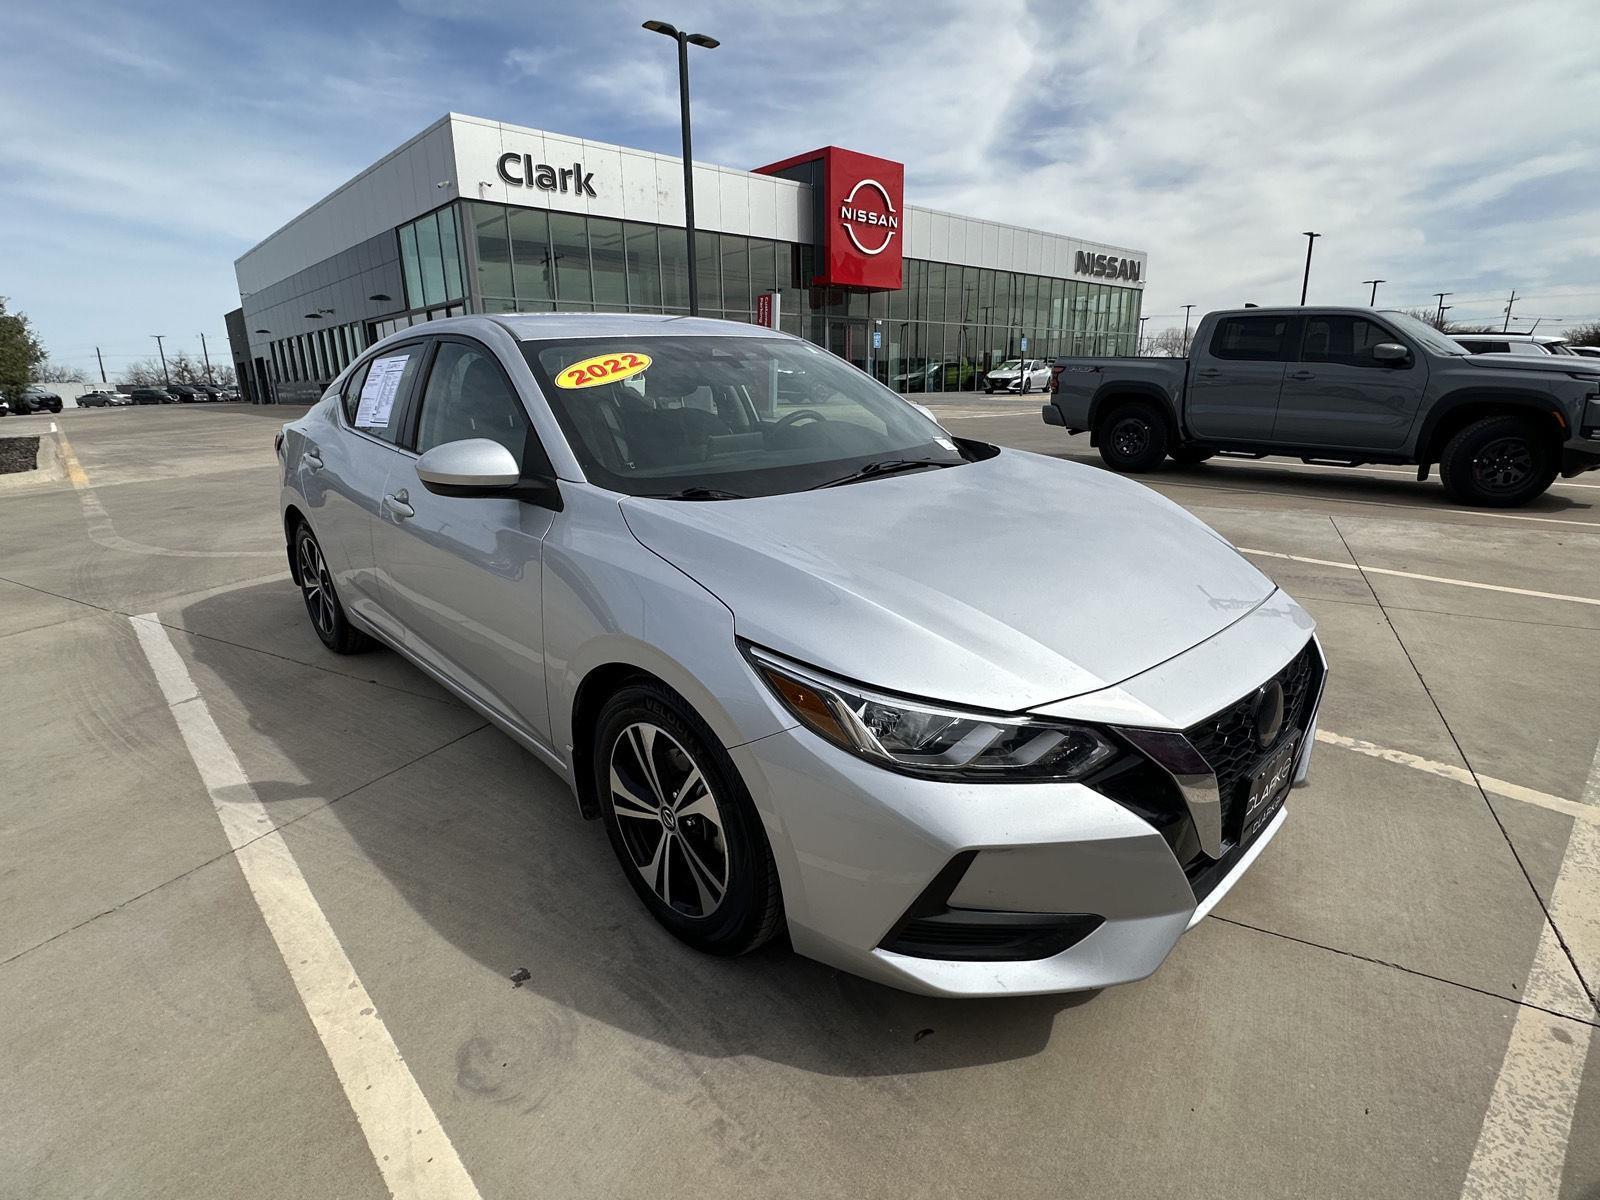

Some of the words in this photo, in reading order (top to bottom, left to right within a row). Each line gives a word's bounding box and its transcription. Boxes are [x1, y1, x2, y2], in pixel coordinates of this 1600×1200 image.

[497, 152, 597, 197] Clark
[841, 206, 898, 228] NISSAN
[1075, 250, 1141, 281] NISSAN
[568, 355, 644, 385] 2022
